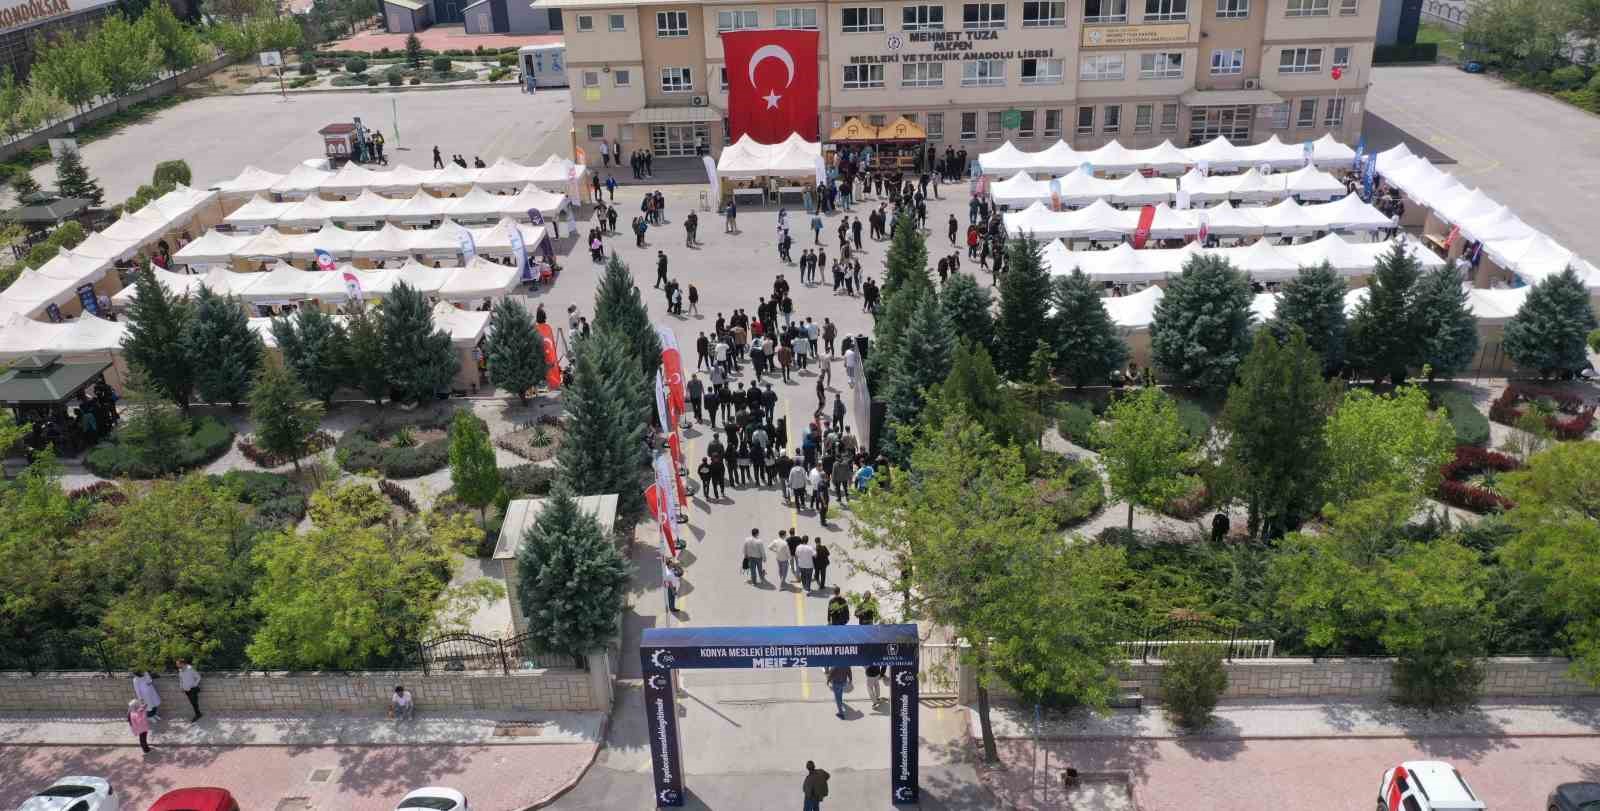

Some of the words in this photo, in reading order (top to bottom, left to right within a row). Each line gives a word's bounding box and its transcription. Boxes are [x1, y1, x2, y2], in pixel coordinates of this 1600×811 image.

[910, 32, 962, 42] MEHMET
[966, 31, 998, 40] TUZA
[934, 41, 973, 52] PAKPEN
[850, 54, 899, 64] MESLEKİ
[902, 54, 916, 62] VE
[918, 52, 960, 62] TEKNİK
[963, 51, 1014, 60] ANADOLU
[1017, 48, 1053, 59] LİSESİ
[700, 647, 727, 657] KONYA
[728, 646, 764, 657] MESLEKİ
[765, 645, 793, 657] EĞİTİM
[794, 644, 832, 657] İSTİHDAM
[834, 645, 858, 656] FUARI
